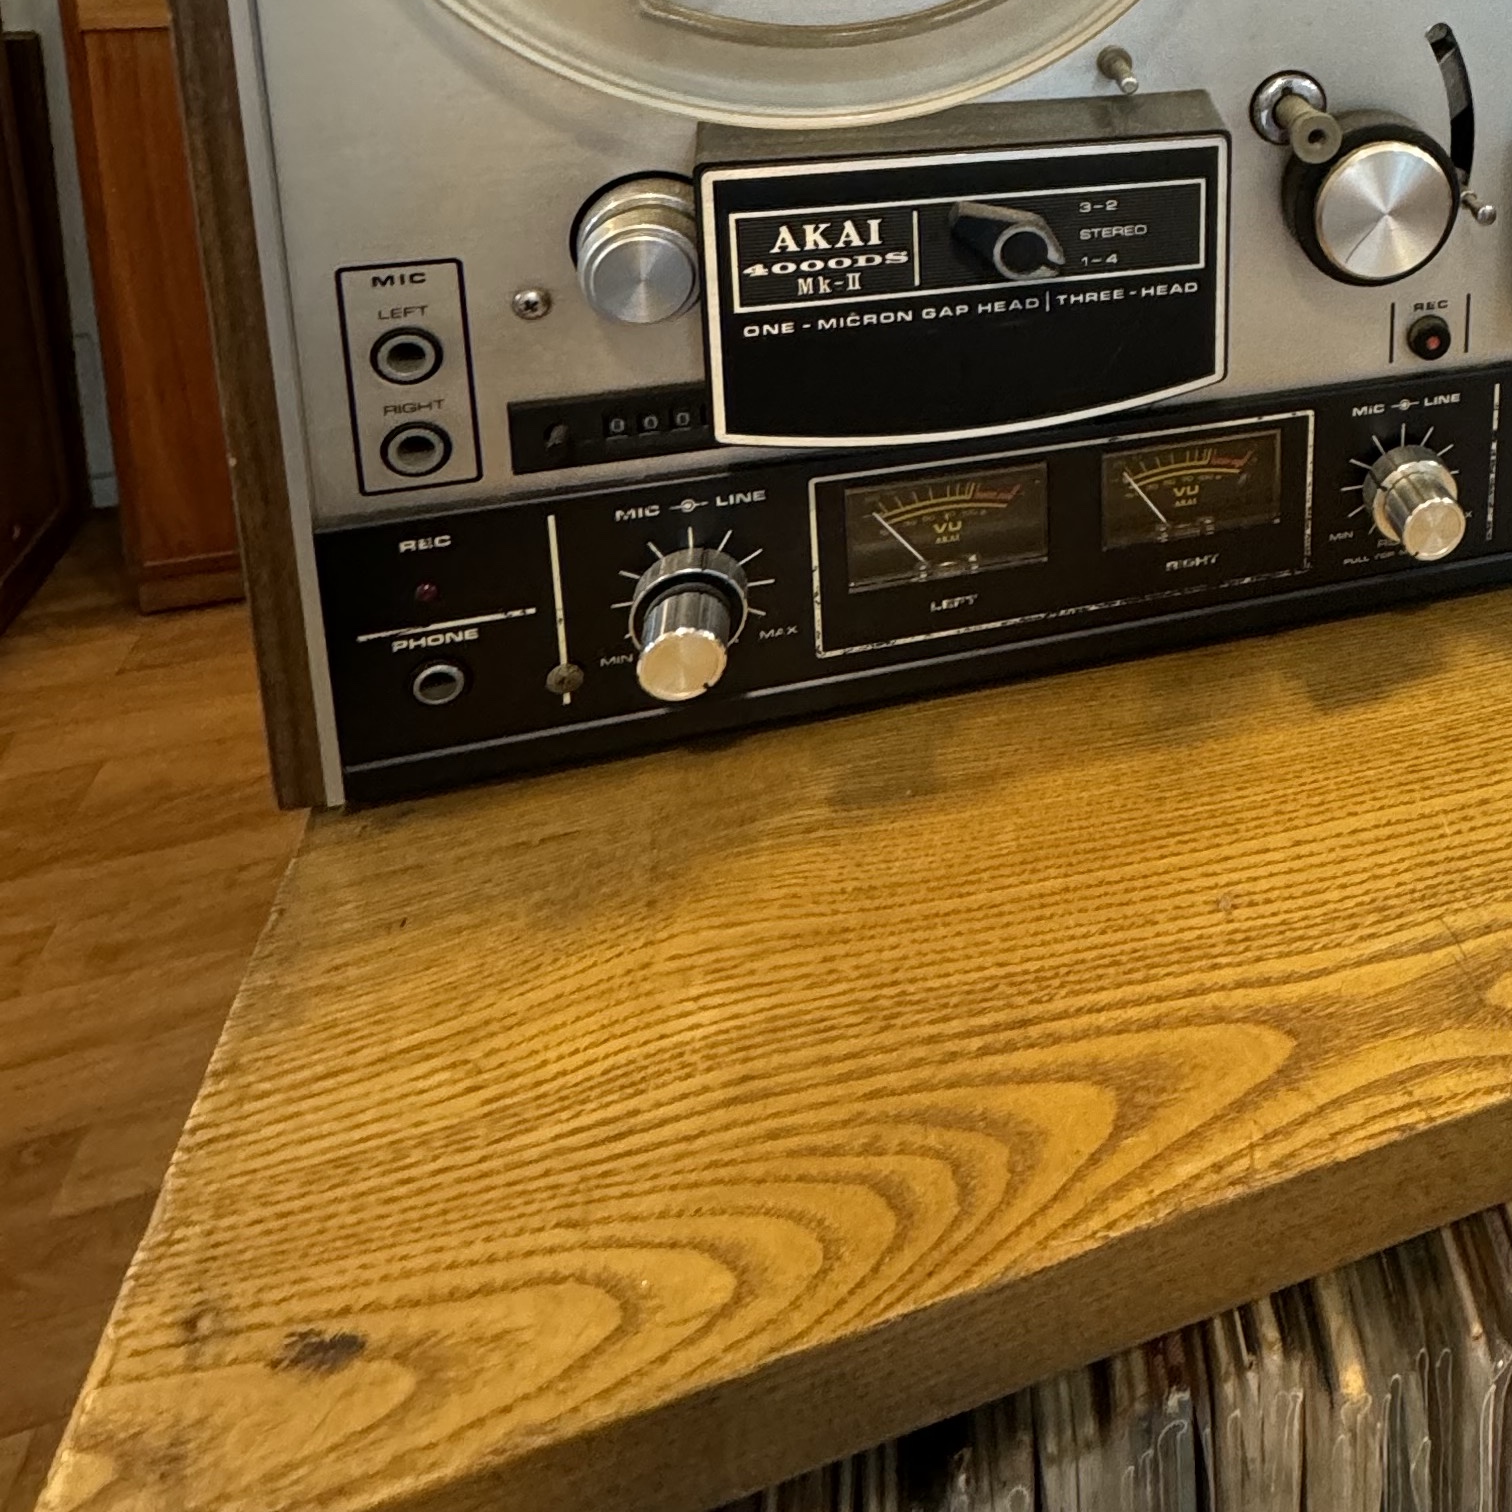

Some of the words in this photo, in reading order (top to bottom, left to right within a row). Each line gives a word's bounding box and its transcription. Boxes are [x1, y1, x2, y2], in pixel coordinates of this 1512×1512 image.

[1078, 199, 1119, 213] 3-2
[769, 218, 884, 254] AKAI
[1078, 224, 1149, 241] STEREO
[742, 249, 910, 277] 4000DS
[1080, 253, 1118, 267] 1-4
[371, 271, 428, 288] MIC
[377, 304, 429, 321] LEFT
[921, 303, 969, 320] GAP
[977, 297, 1040, 314] HEAD
[1413, 299, 1449, 312] REC
[382, 398, 446, 417] RIGHT
[1352, 403, 1385, 417] MIC
[1423, 392, 1461, 407] LINE
[1173, 484, 1200, 497] VU
[615, 503, 661, 522] MIC
[715, 490, 767, 507] LINE
[933, 520, 962, 534] VU
[399, 534, 452, 553] REC
[1165, 552, 1220, 572] RIGHT
[392, 627, 480, 653] PHONE
[758, 623, 799, 640] MAX
[600, 652, 634, 668] MIN
